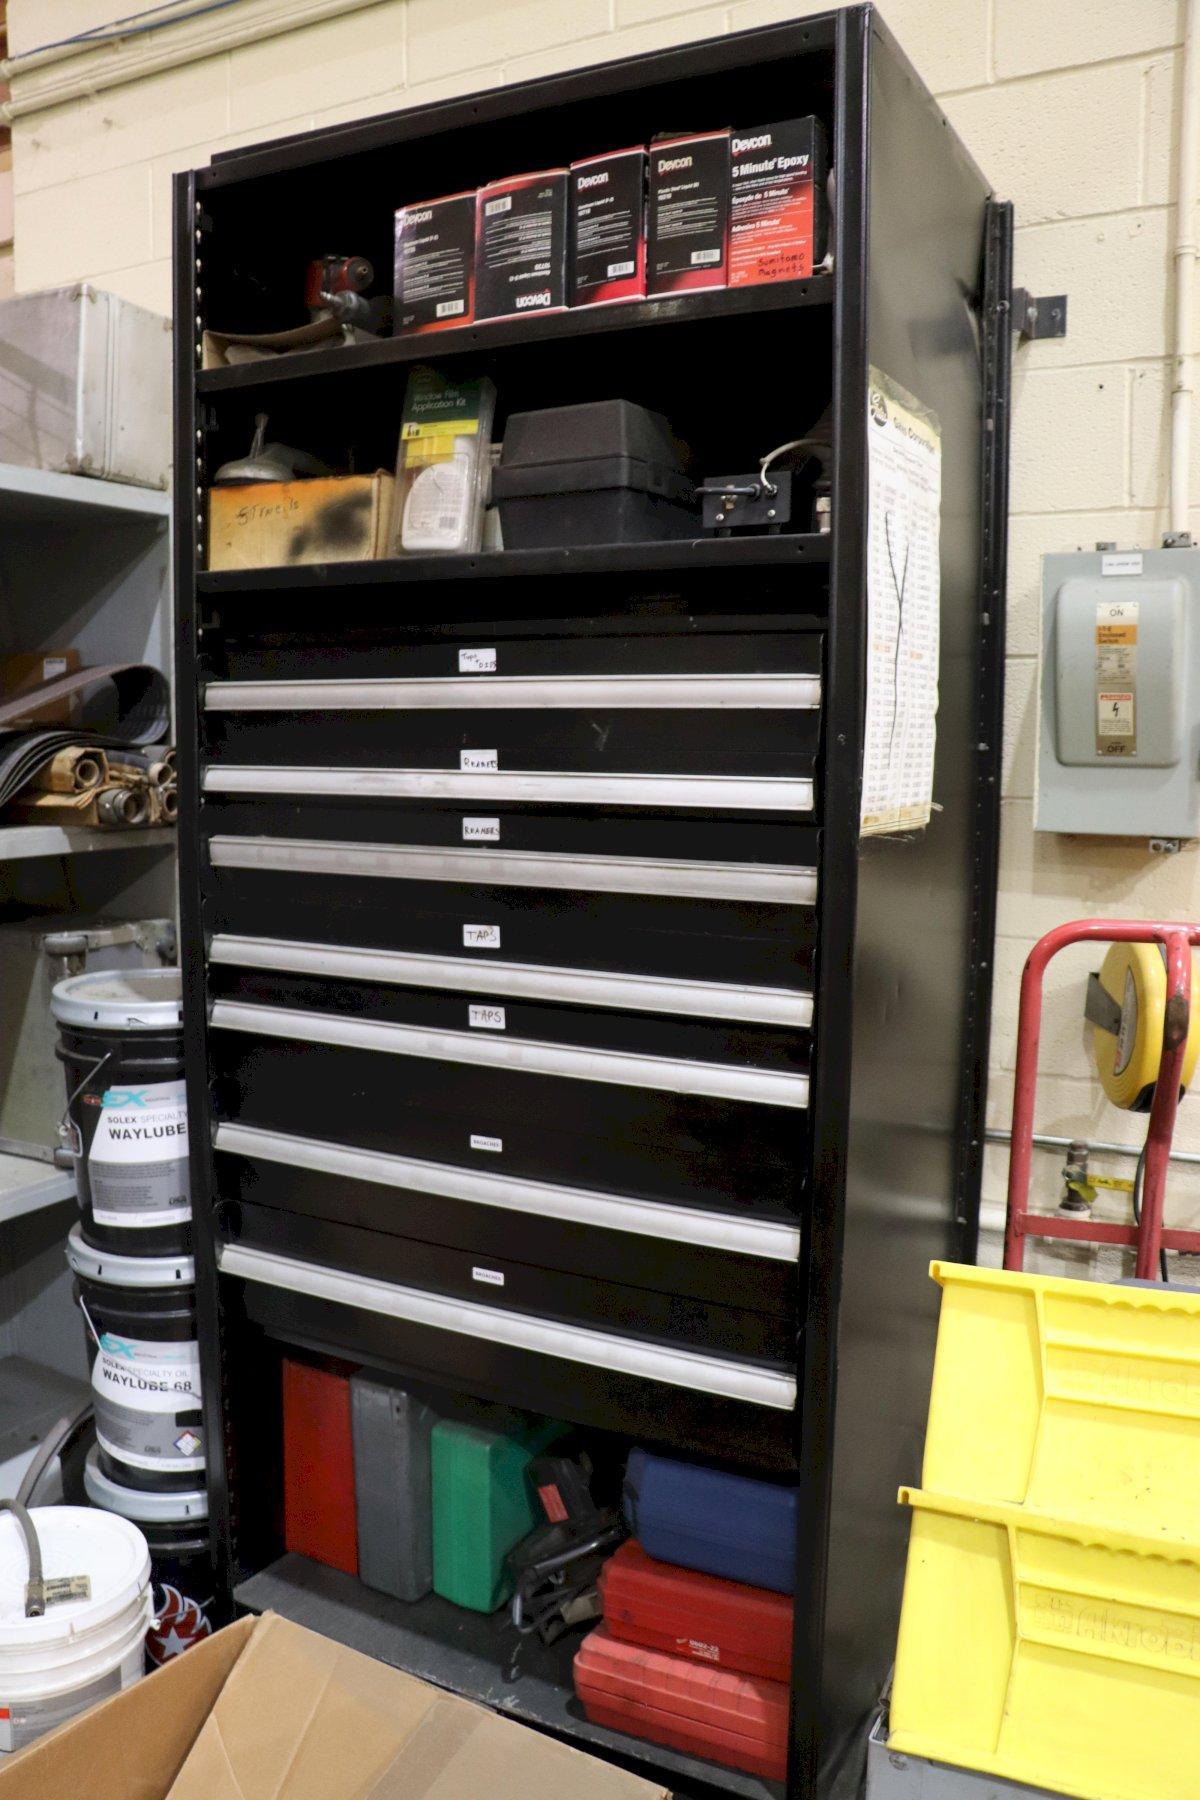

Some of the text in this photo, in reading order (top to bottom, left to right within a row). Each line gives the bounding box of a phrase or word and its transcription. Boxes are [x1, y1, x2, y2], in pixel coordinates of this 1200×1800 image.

[732, 134, 772, 153] Devcon
[658, 156, 693, 173] Devcon
[732, 166, 739, 177] 5
[777, 154, 809, 170] Epoxy
[577, 172, 609, 190] Devcon
[403, 210, 433, 226] Devcon
[516, 292, 552, 308] Devcon
[411, 397, 466, 414] Application Kit
[1109, 608, 1124, 617] ON
[1107, 744, 1126, 753] OFF
[466, 927, 498, 943] TAPS
[471, 1009, 502, 1023] TAPS
[108, 1116, 137, 1124] SOLEX
[109, 1122, 187, 1140] WAYLUBE
[102, 1367, 192, 1392] WAYLUBE 68
[176, 1369, 188, 1377] OIL
